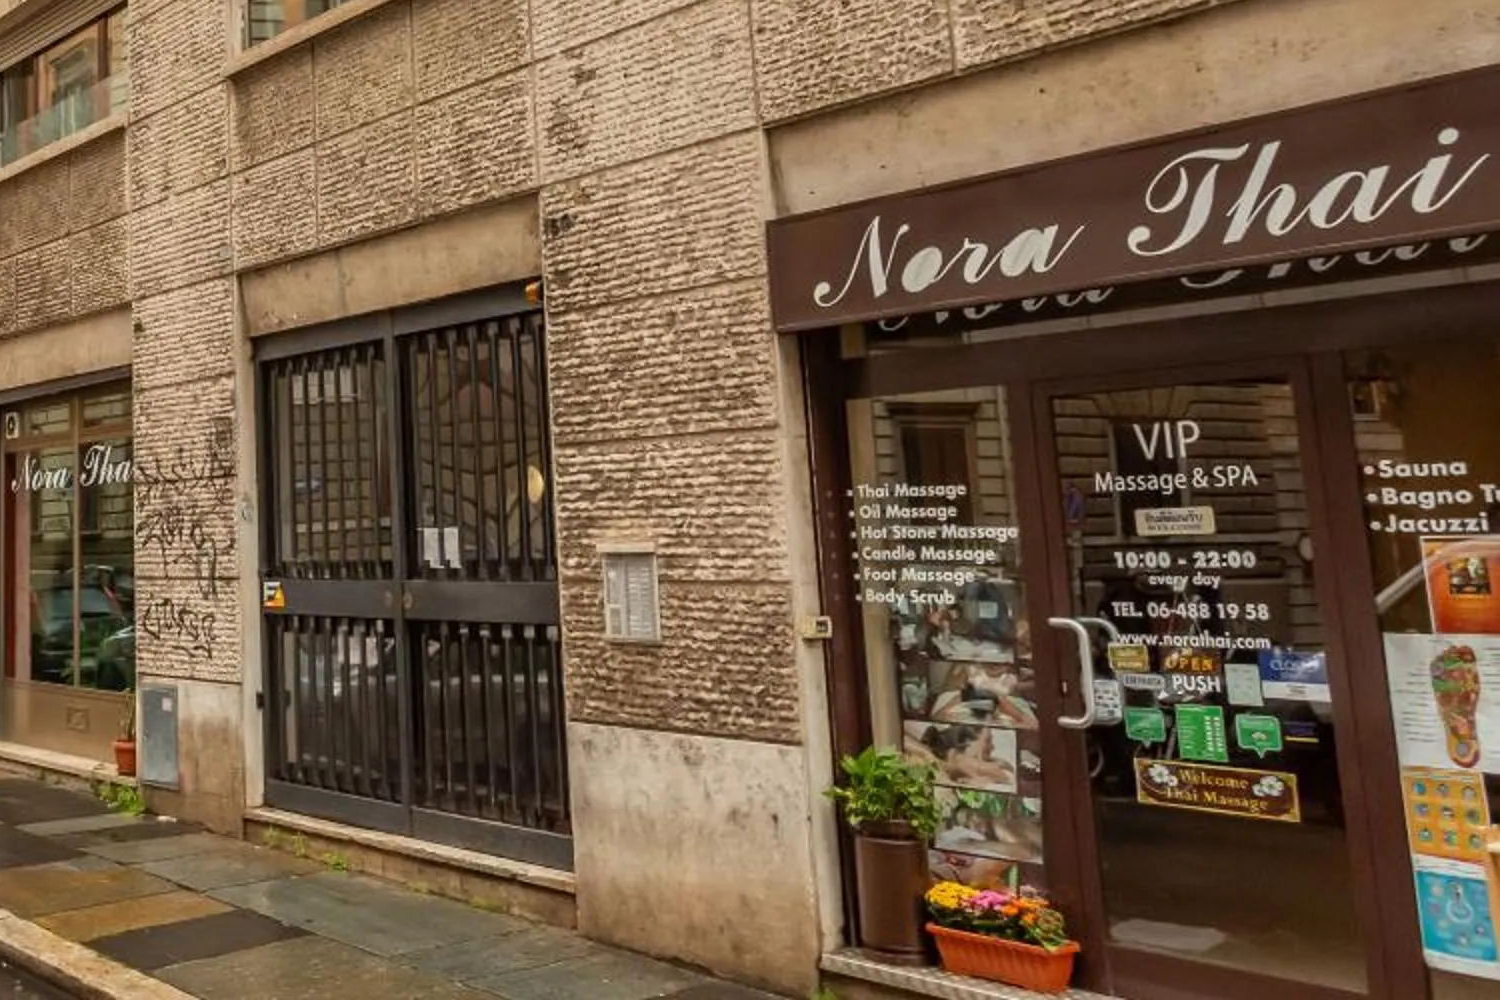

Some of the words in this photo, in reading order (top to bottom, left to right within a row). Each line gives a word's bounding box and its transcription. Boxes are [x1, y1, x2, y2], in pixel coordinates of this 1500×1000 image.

[812, 214, 1086, 308] Nora
[1126, 127, 1491, 257] Thai
[1132, 419, 1201, 460] VIP
[11, 453, 72, 494] Nora
[1377, 459, 1468, 478] Sauna
[1094, 471, 1189, 495] Massage
[1192, 467, 1209, 489] &
[1213, 464, 1259, 487] SPA
[856, 483, 889, 499] Thai
[893, 483, 968, 500] Massage
[1381, 487, 1474, 509] Bagno
[859, 504, 881, 519] Oil
[885, 504, 958, 521] Massage
[1384, 512, 1490, 533] Jacuzzi
[861, 525, 887, 539] Hot
[893, 525, 938, 540] Stone
[941, 524, 1019, 542] Massage
[861, 544, 917, 561] Candle
[920, 546, 997, 564] Massage
[1113, 551, 1172, 569] 10:00
[1192, 551, 1257, 570] 22:00
[863, 567, 897, 581] Foot
[901, 567, 975, 586] Massage
[1148, 573, 1189, 592] every
[1192, 571, 1221, 589] day
[865, 588, 905, 607] Body
[909, 588, 956, 605] Scrub
[1111, 601, 1143, 617] TEL.
[1146, 602, 1211, 619] 06-488
[1216, 603, 1240, 619] 19
[1245, 603, 1270, 621] 58
[1116, 629, 1271, 650] www.norathai.com
[1164, 654, 1213, 671] OPEN
[1172, 674, 1221, 692] PUSH
[1179, 768, 1248, 789] Welcome
[1166, 786, 1199, 801] Thai
[1203, 791, 1269, 813] Massage
